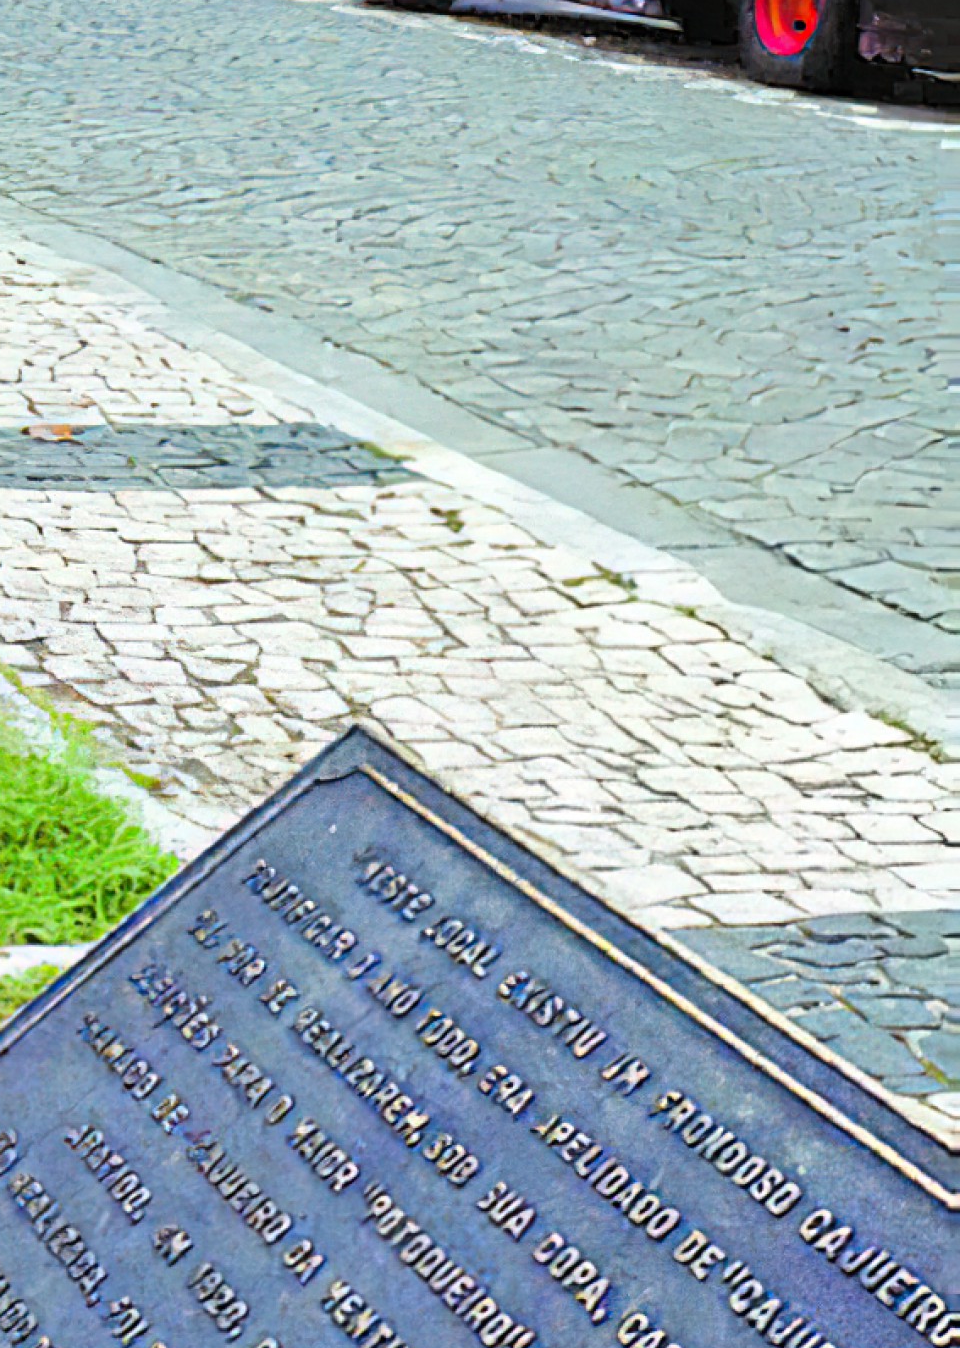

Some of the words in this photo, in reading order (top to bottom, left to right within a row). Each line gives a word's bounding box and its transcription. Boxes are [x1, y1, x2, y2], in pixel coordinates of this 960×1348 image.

[263, 1094, 295, 1124] O
[286, 1118, 362, 1191] MAIOR
[497, 971, 606, 1057] EXISTIU
[648, 1090, 805, 1214] FRONDOSO
[422, 1133, 481, 1186] SOB
[478, 1184, 538, 1238] SUA
[477, 1065, 536, 1115] ERA
[531, 1112, 681, 1238] APELIDADO
[672, 1232, 726, 1278] DE
[281, 1239, 326, 1283] DA
